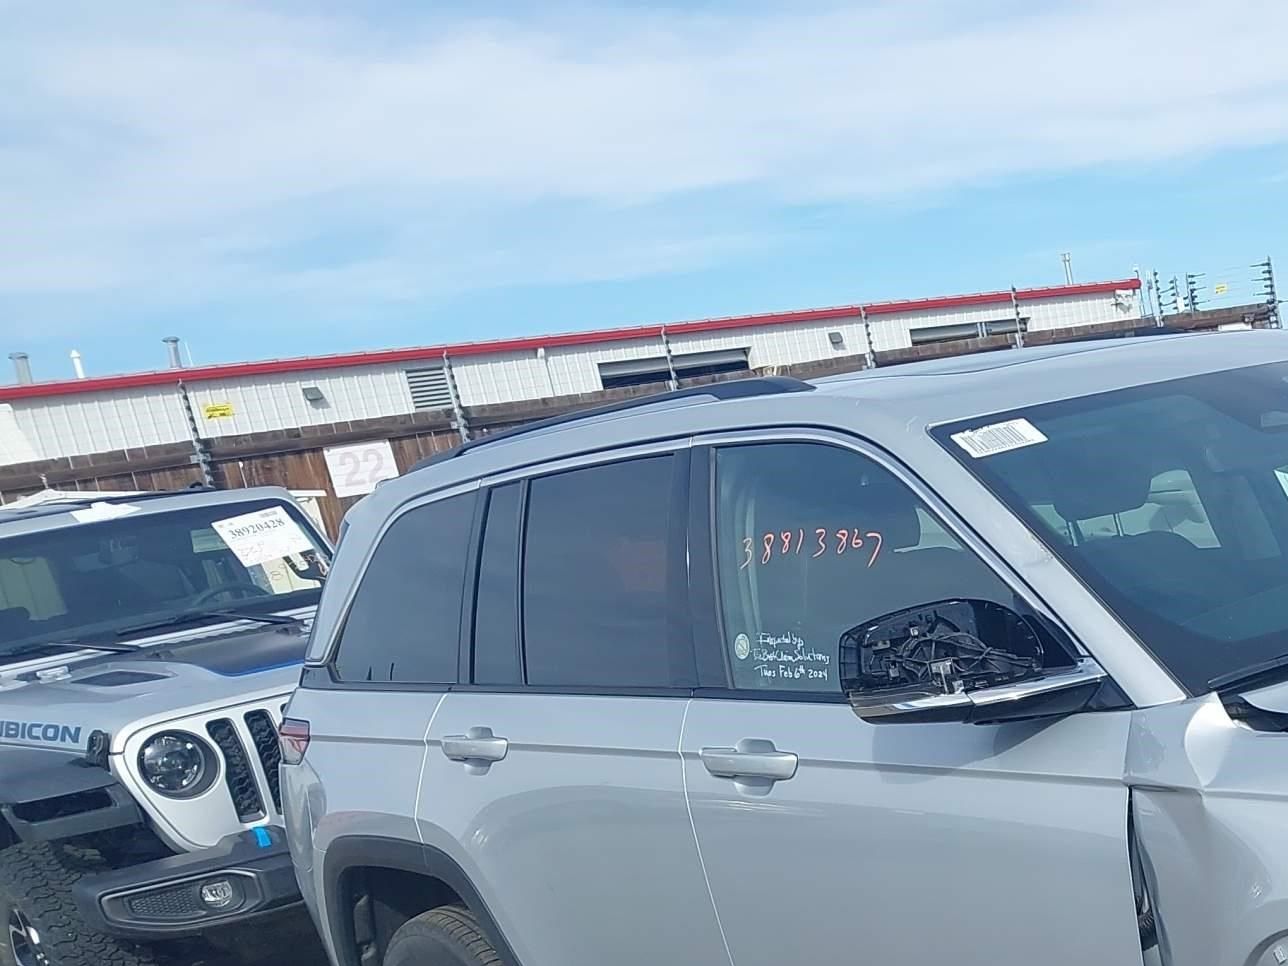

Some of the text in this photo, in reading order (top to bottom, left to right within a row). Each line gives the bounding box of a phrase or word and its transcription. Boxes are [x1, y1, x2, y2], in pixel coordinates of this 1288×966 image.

[338, 448, 384, 487] 22
[228, 517, 286, 540] 38920428
[739, 527, 883, 570] 38813867
[779, 664, 793, 678] Feb
[808, 668, 828, 681] 2024
